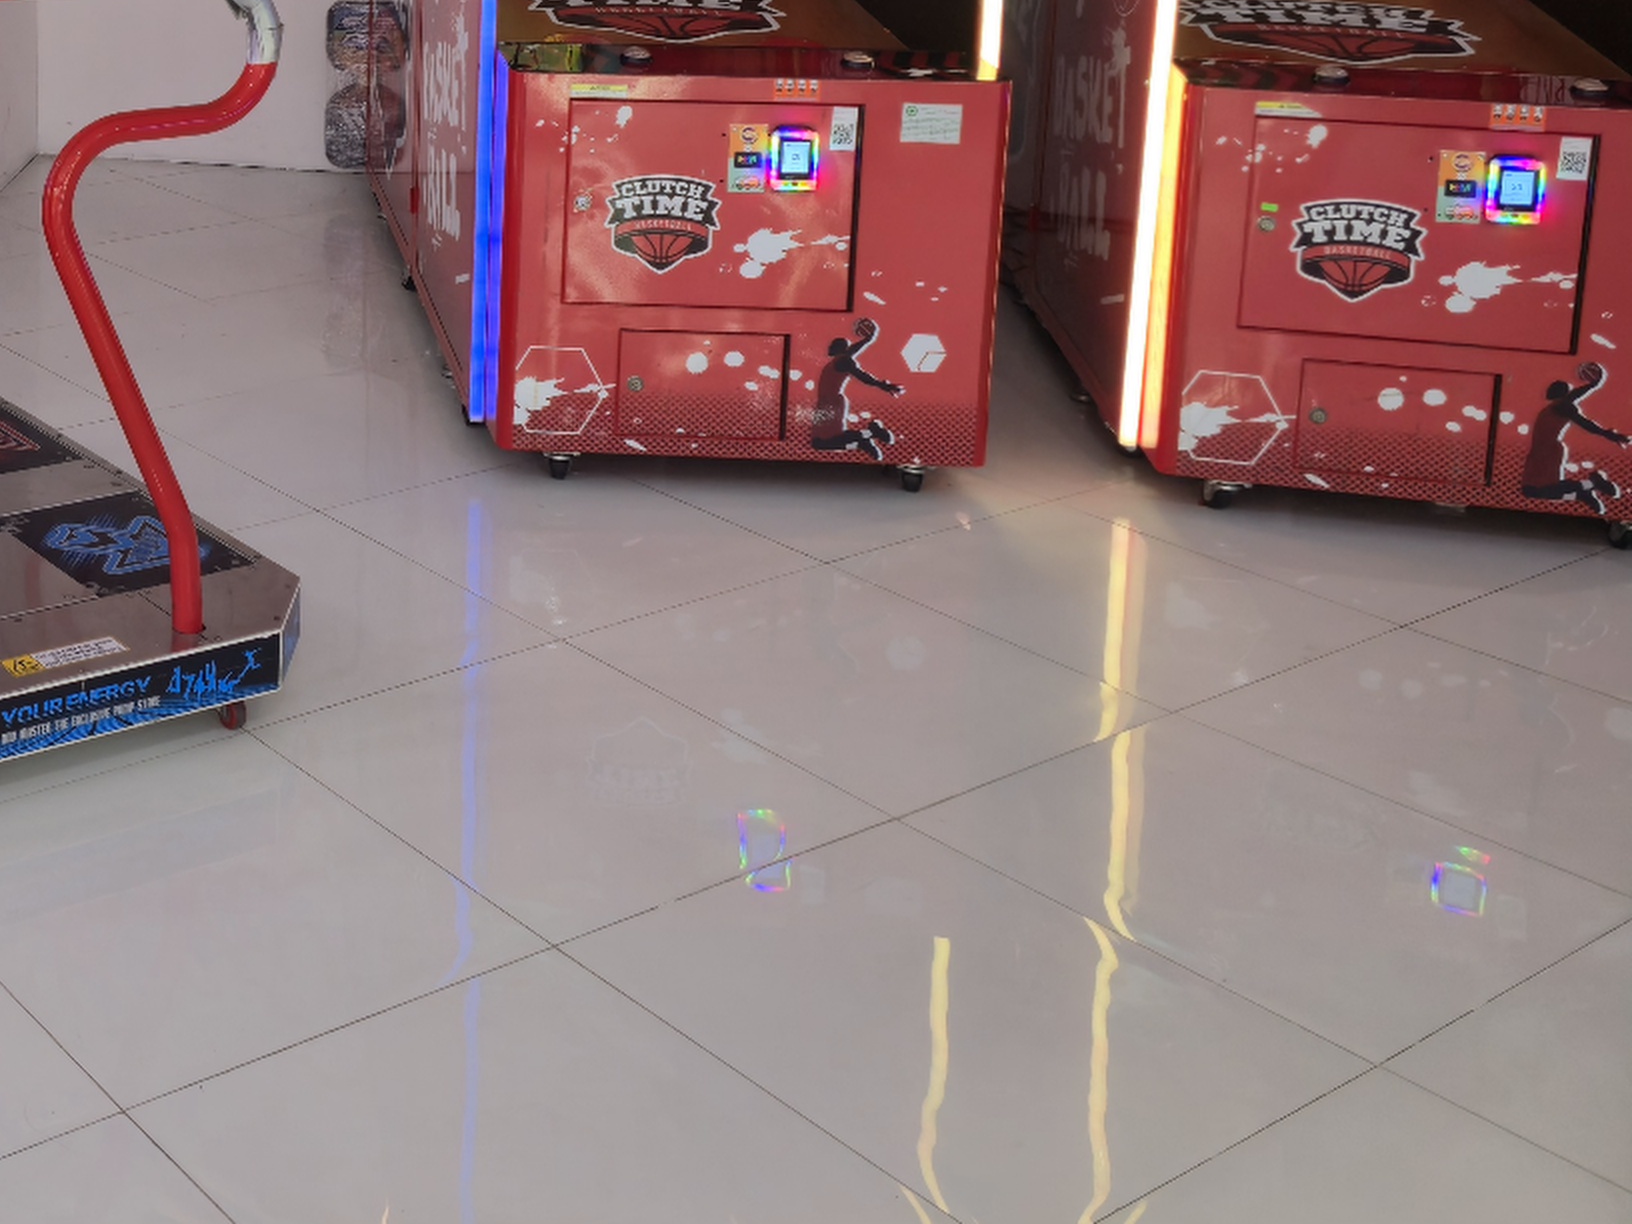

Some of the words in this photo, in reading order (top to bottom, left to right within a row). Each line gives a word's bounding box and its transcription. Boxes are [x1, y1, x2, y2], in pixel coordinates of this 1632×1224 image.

[620, 180, 705, 198] CLUTCH
[616, 195, 709, 221] TIME
[1309, 204, 1409, 227] CLUTCH
[1302, 219, 1412, 250] TIME
[1, 699, 64, 732] YOUR
[66, 676, 151, 712] ENERGY
